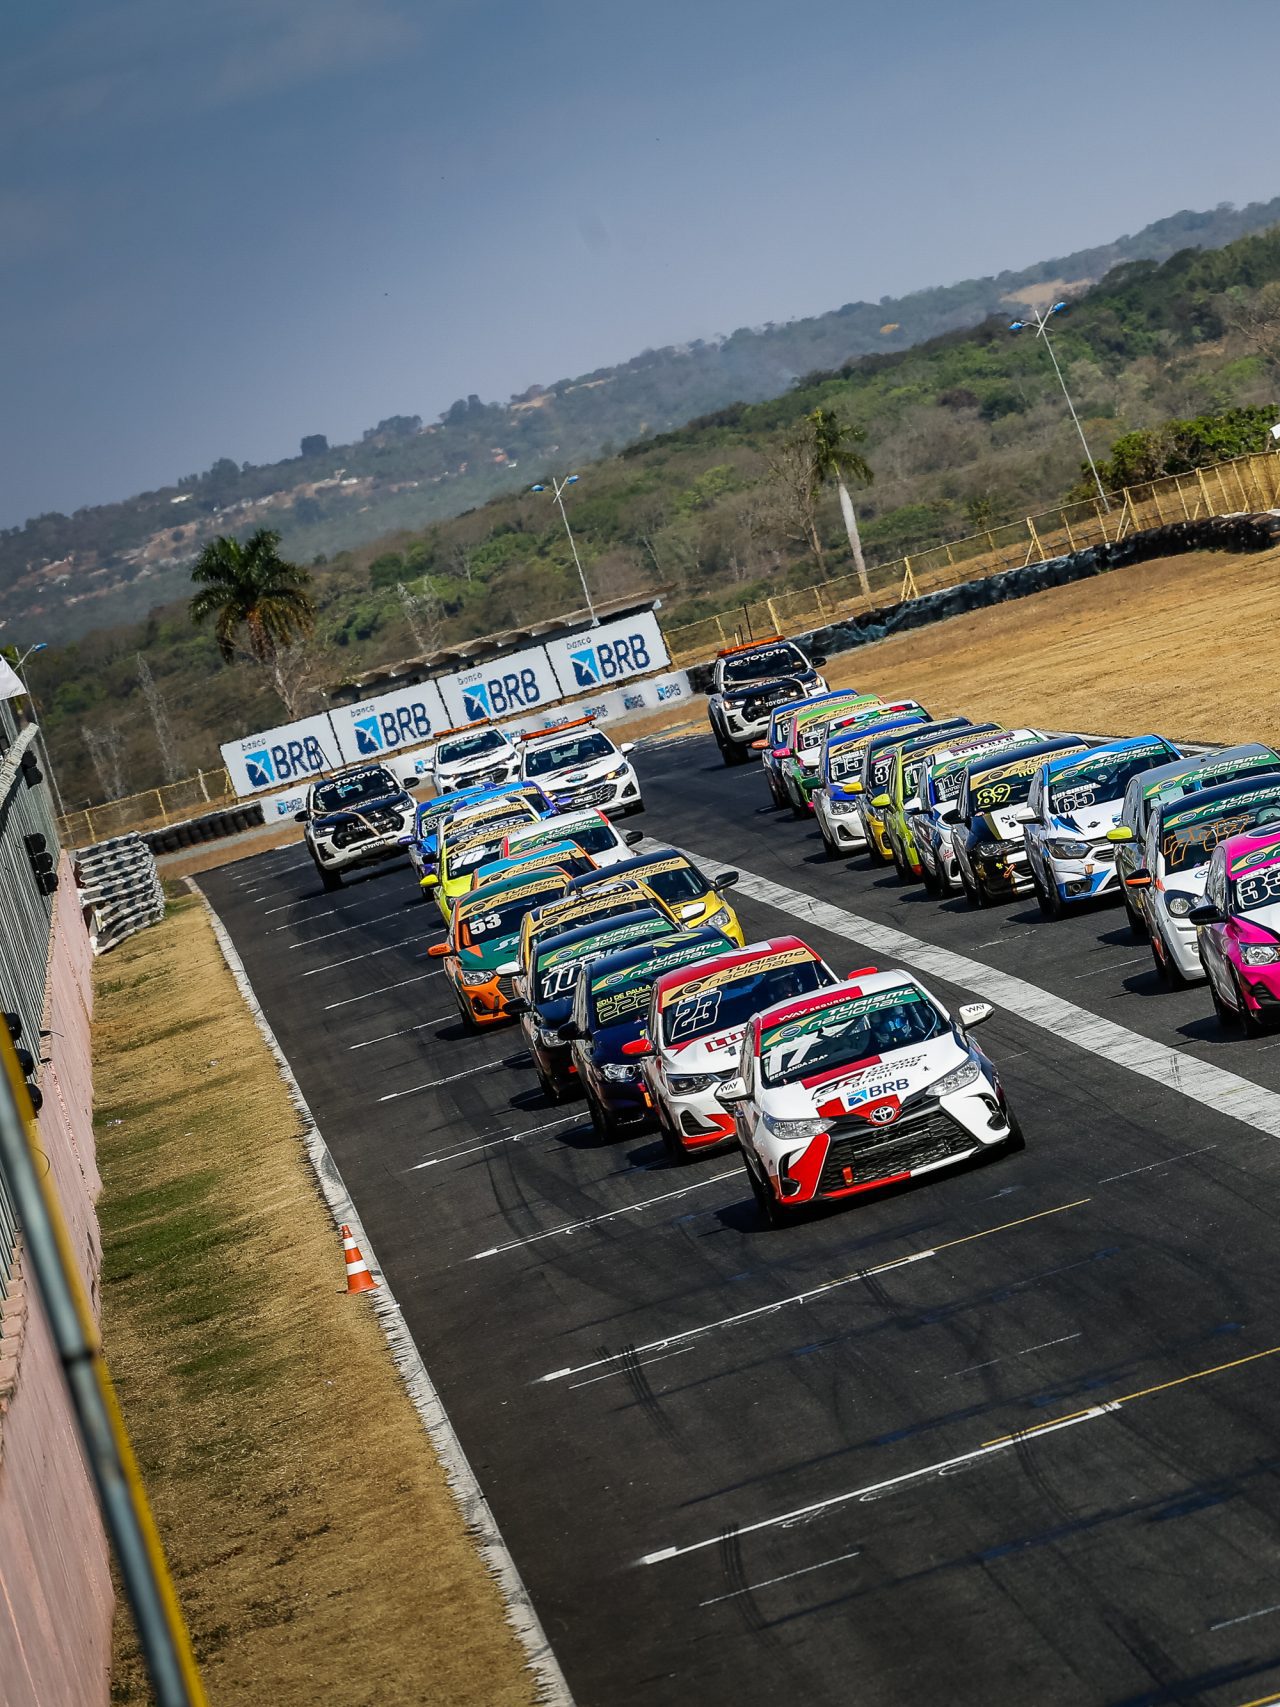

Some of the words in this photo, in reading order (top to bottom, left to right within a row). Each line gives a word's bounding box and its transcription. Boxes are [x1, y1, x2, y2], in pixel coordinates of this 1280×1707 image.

[566, 636, 592, 650] banco
[598, 634, 651, 679] BRB
[743, 648, 789, 662] TOYOTA
[457, 671, 483, 686] banco
[489, 668, 541, 714] BRB
[350, 704, 376, 717] banco
[379, 702, 432, 747] BRB
[241, 738, 267, 751] banco
[1098, 744, 1166, 763] TURISMO
[271, 735, 324, 780] BRB
[1197, 753, 1271, 774] TURISMO
[338, 769, 381, 787] TOYOTA
[977, 783, 1011, 808] 89
[1056, 789, 1096, 814] 65
[521, 849, 578, 867] TURISMO
[617, 858, 682, 879] TURISMO
[505, 878, 566, 897] TURISMO
[579, 890, 645, 909] TURISMO
[469, 912, 502, 935] 53
[594, 920, 667, 942] TURISMO
[646, 940, 723, 966] TURISMO
[725, 950, 806, 974] TURISMO
[614, 993, 625, 1001] DE
[625, 984, 652, 996] PAULA
[827, 987, 918, 1015] TURISMO
[671, 990, 722, 1042] 23
[778, 1008, 808, 1021] WAY
[809, 996, 852, 1012] SEGUROS
[965, 1003, 985, 1014] WAY
[761, 1031, 822, 1079] 17
[769, 1062, 808, 1081] BERLANDA
[852, 1072, 892, 1088] Brasil
[719, 1081, 738, 1095] WAY
[869, 1078, 910, 1098] BRB
